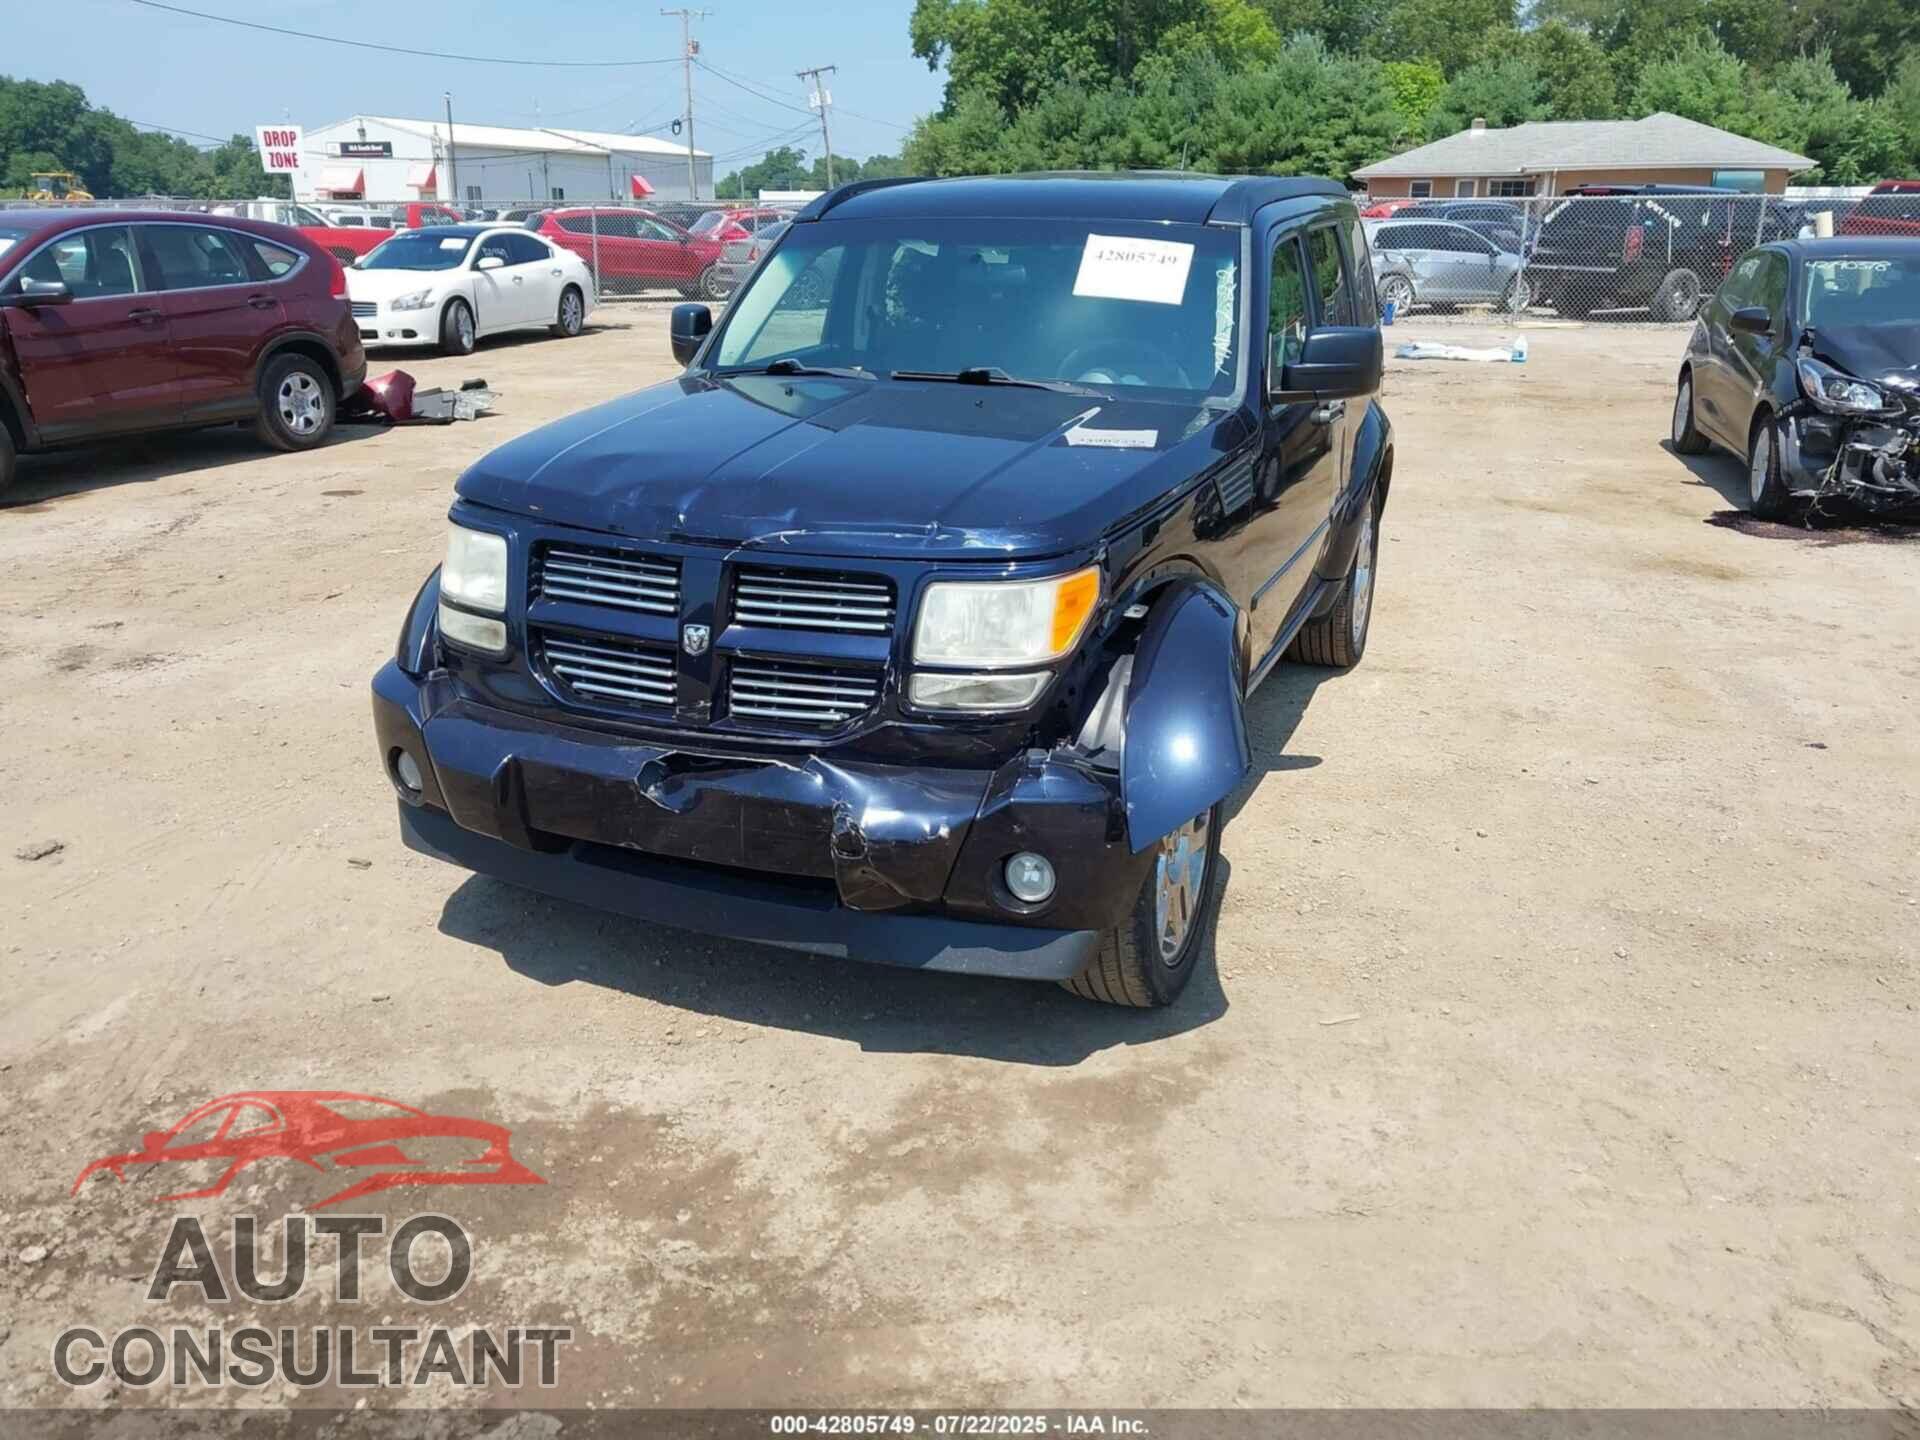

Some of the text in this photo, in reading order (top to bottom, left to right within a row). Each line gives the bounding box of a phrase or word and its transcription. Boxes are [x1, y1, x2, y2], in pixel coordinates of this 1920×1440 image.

[263, 131, 297, 147] DROP
[269, 152, 299, 168] ZONE
[1095, 249, 1178, 265] 42805749
